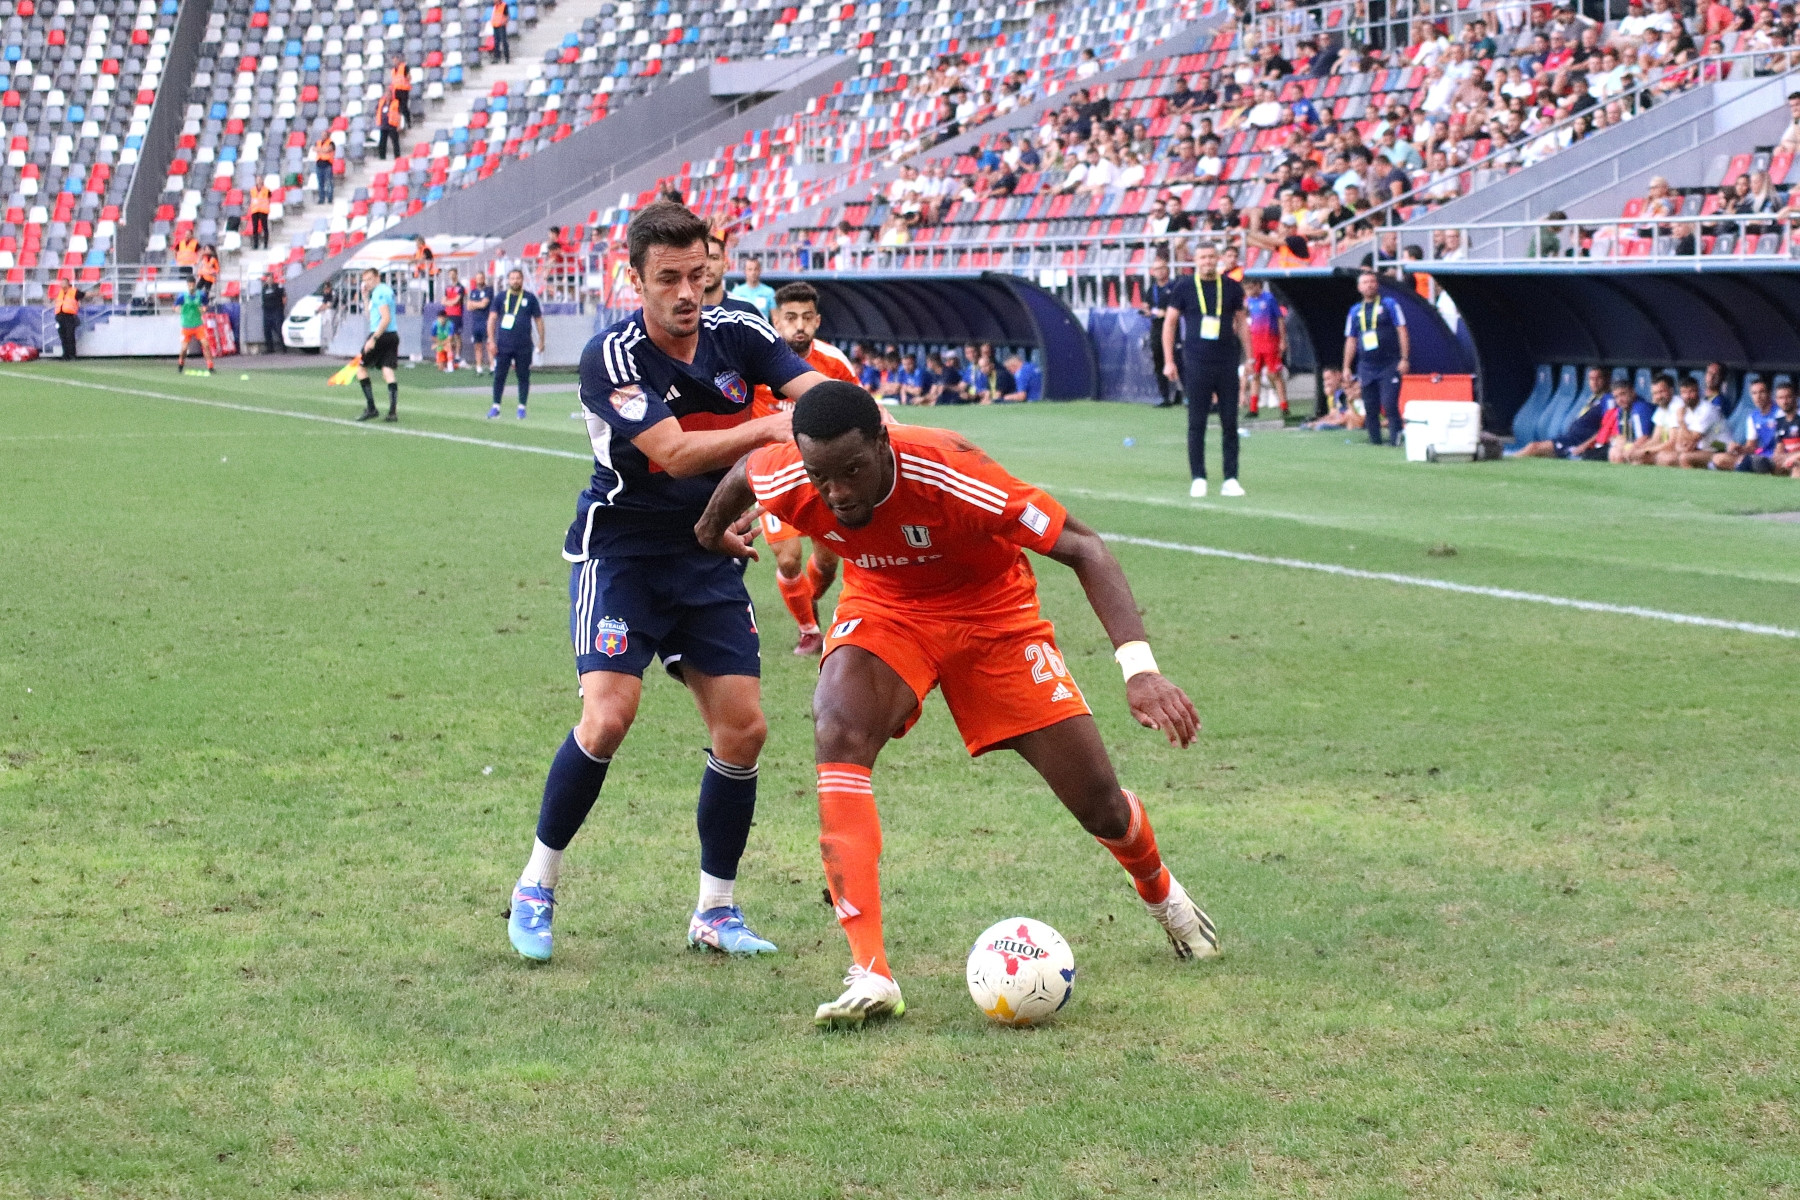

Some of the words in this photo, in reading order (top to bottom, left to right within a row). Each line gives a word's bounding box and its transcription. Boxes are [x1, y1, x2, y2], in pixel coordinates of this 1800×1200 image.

[901, 525, 932, 548] U
[600, 620, 626, 630] STEAUA
[1025, 642, 1066, 684] 26
